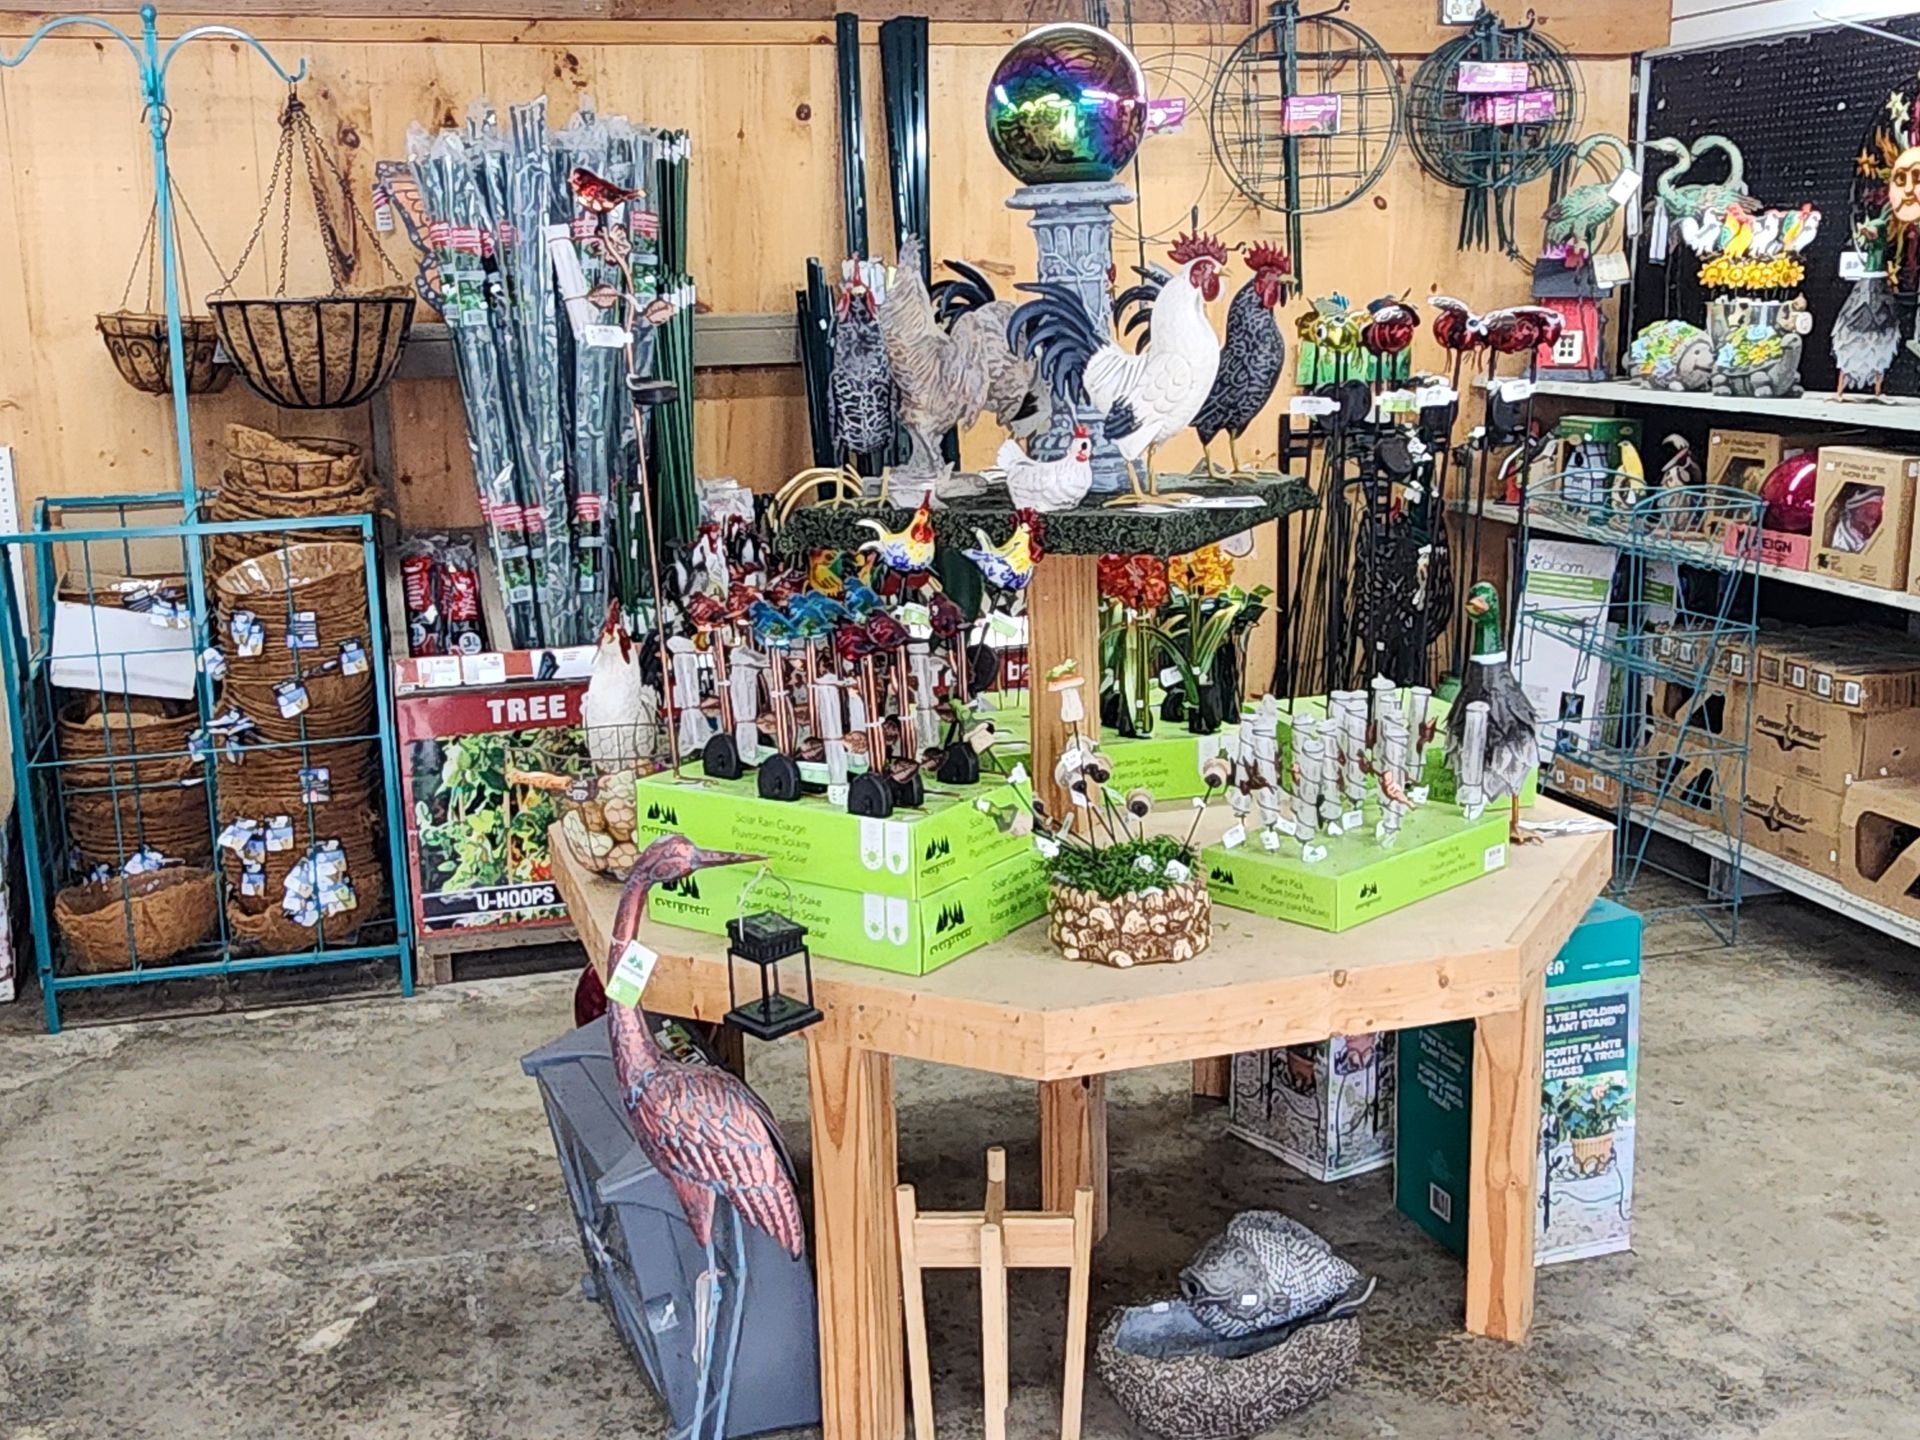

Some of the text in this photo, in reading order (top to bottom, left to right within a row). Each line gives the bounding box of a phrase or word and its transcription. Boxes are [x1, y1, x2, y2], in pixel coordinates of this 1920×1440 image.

[487, 694, 567, 724] TREE
[476, 886, 555, 911] U-HOOPS
[655, 898, 710, 917] evergreen
[1554, 1011, 1577, 1022] TIER
[1580, 1004, 1626, 1020] FOLDING
[1546, 1016, 1616, 1035] PLANT STAND
[1581, 1039, 1621, 1053] PLANTE
